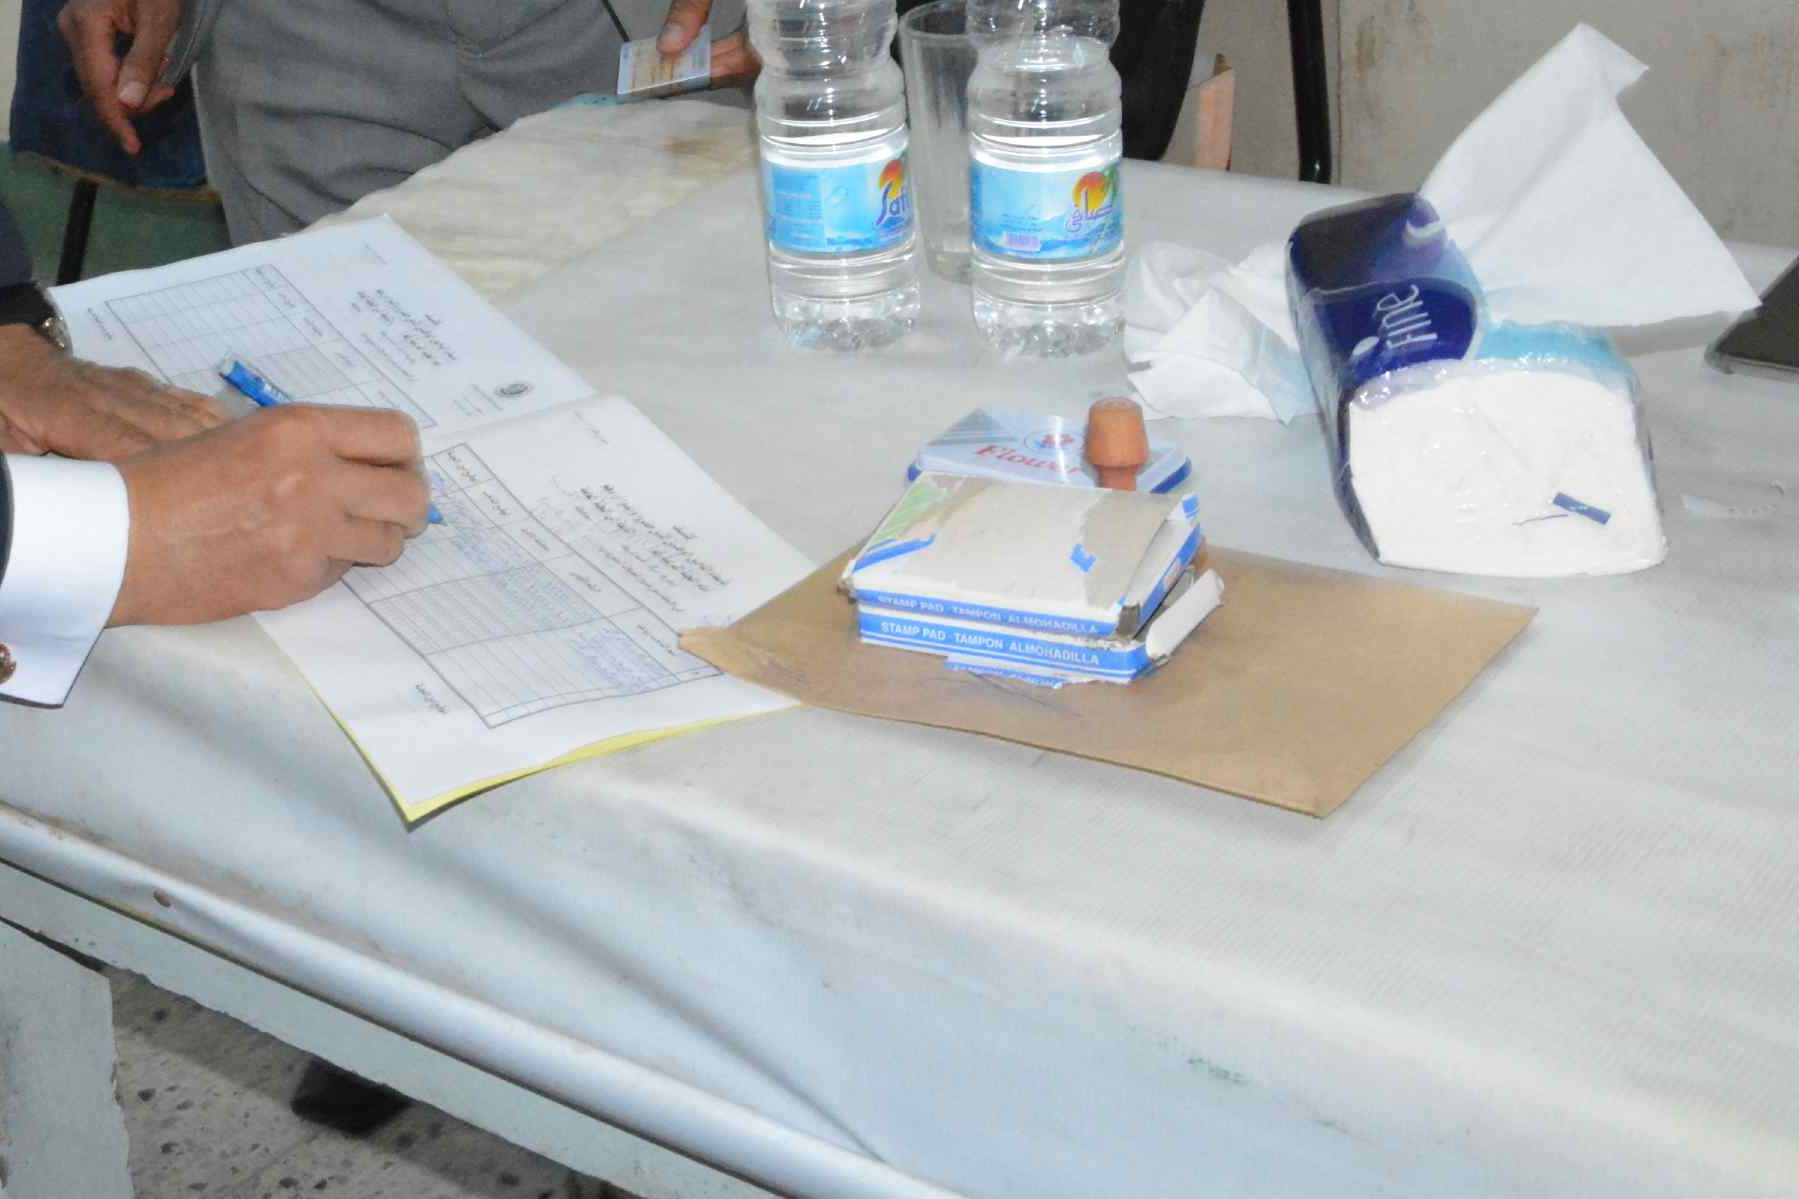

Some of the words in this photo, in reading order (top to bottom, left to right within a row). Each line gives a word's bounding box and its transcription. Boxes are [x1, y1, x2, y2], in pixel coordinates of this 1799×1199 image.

[880, 621, 920, 637] STAMP
[922, 627, 946, 641] PAD
[954, 632, 1003, 649] TAMPON
[1009, 642, 1099, 664] ALMOHADILLA
